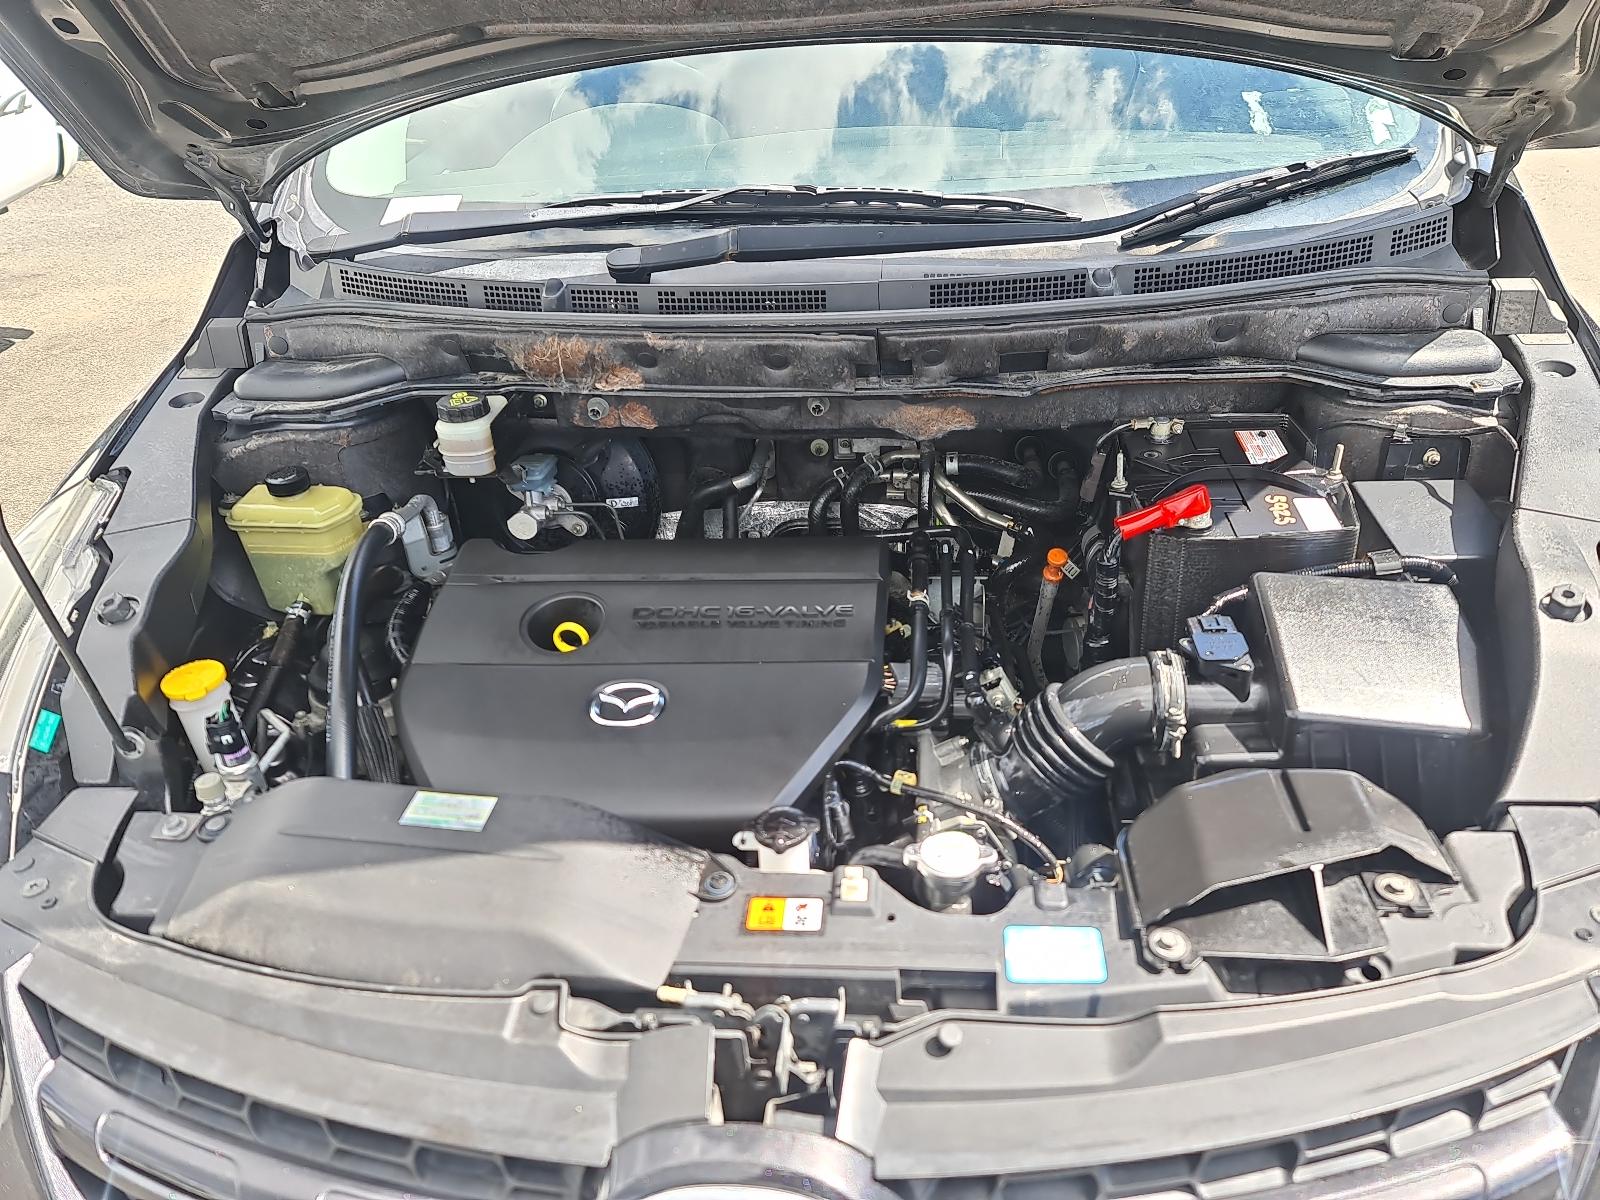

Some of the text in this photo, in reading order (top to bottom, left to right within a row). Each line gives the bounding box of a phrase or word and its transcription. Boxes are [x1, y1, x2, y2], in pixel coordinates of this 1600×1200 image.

[632, 604, 854, 620] DOHC 16-VALVE
[727, 620, 780, 630] VALVE
